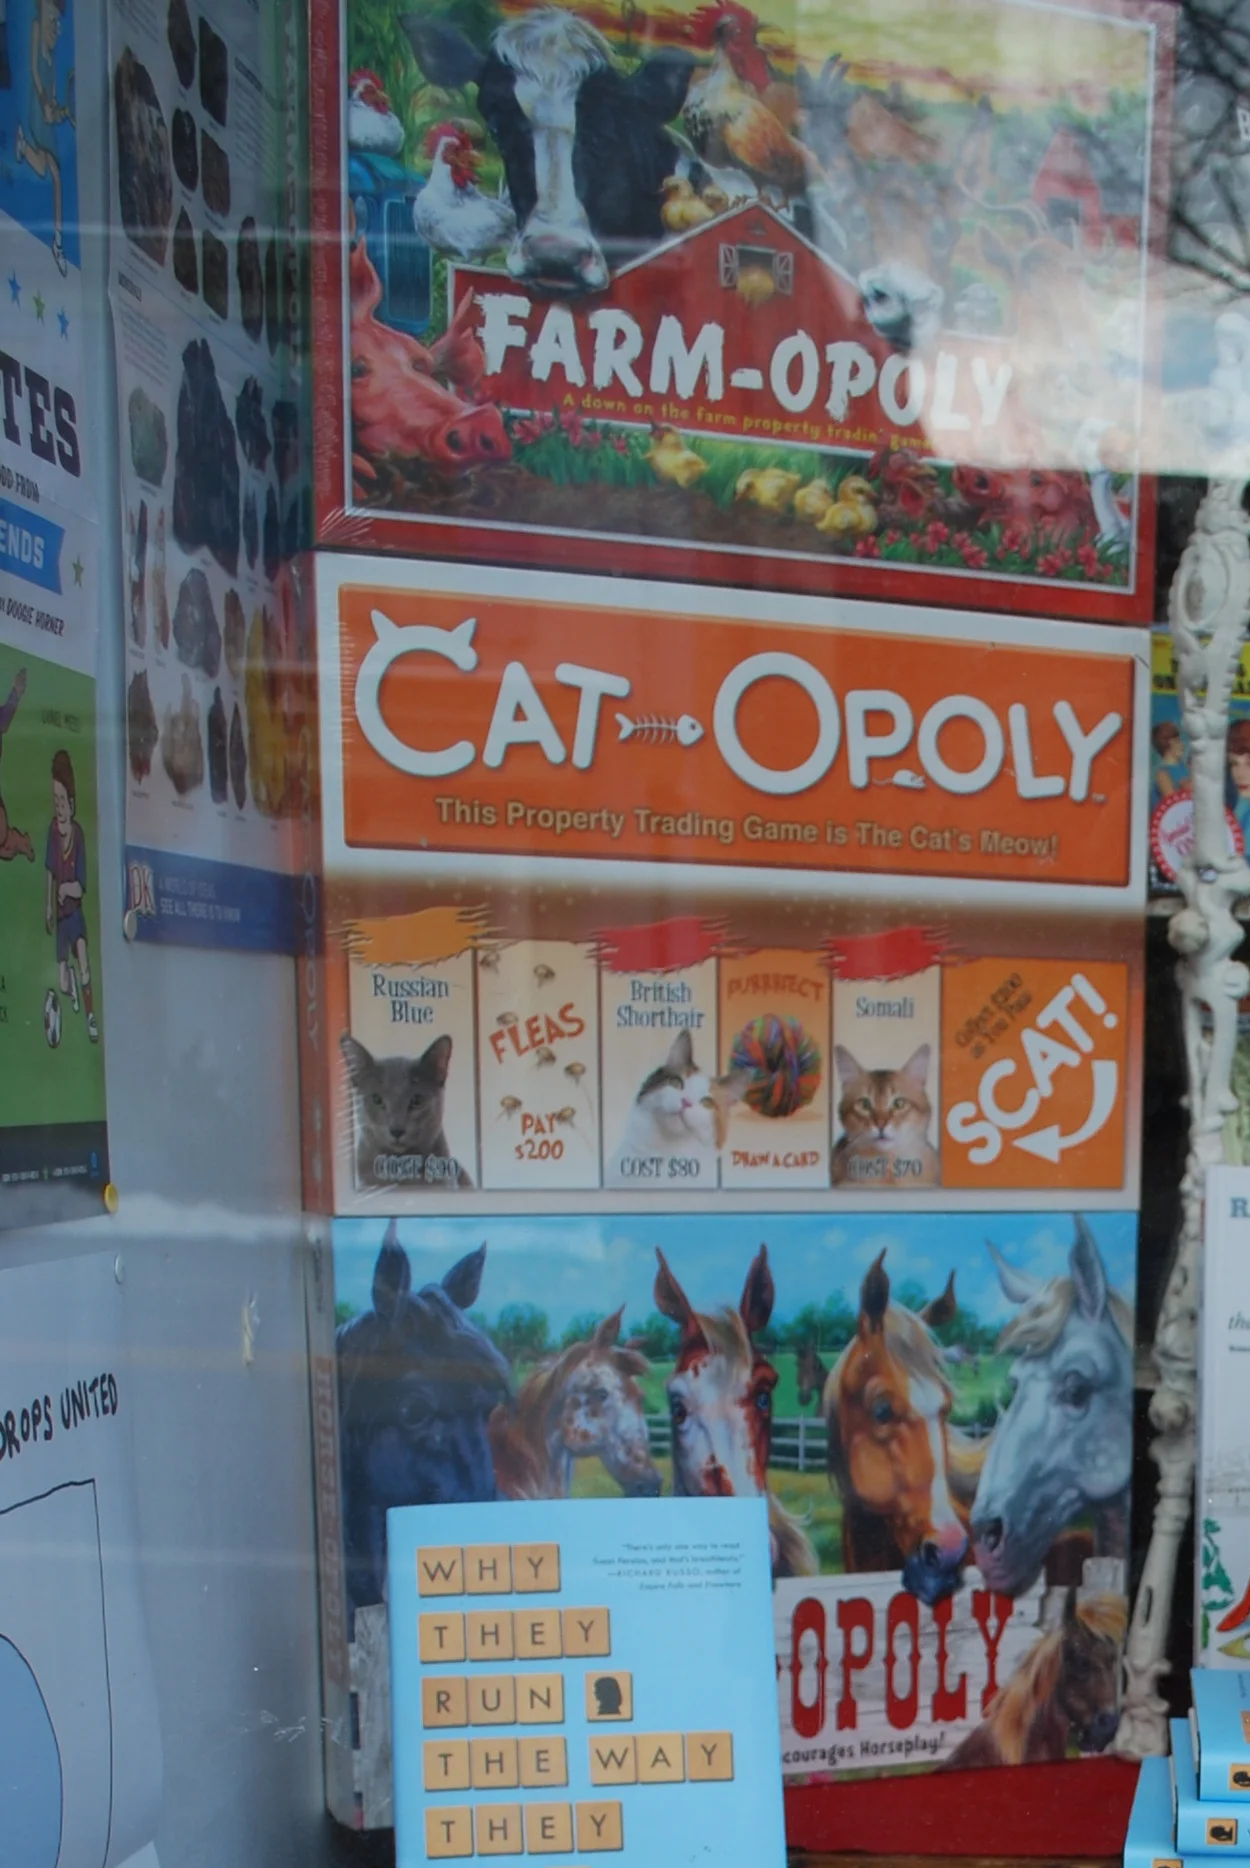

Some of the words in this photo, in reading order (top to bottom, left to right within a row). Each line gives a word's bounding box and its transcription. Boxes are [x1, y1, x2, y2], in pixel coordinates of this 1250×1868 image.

[475, 293, 1014, 433] FARM-OPOLY
[563, 394, 576, 407] A
[581, 394, 627, 414] down
[633, 402, 654, 415] on
[660, 402, 690, 420] the
[696, 408, 736, 426] farm
[742, 415, 820, 440] property
[435, 797, 498, 825] This
[507, 802, 625, 837] Property
[633, 808, 736, 843] Trading
[743, 816, 818, 843] Game
[826, 820, 849, 845] is
[855, 821, 901, 848] The
[909, 826, 972, 852] Cat's
[980, 829, 1059, 859] Meow!
[372, 974, 449, 998] Russian
[630, 980, 692, 1003] British
[391, 1001, 433, 1024] Blue
[616, 1006, 704, 1029] Shorthair
[856, 996, 915, 1018] Somali
[489, 1002, 585, 1064] FLEAS
[946, 972, 1118, 1165] SCAT!
[522, 1113, 556, 1136] PAY
[620, 1156, 663, 1178] COST
[668, 1157, 699, 1178] $80
[60, 1373, 118, 1430] UNITED
[860, 1732, 946, 1760] Horseplay!
